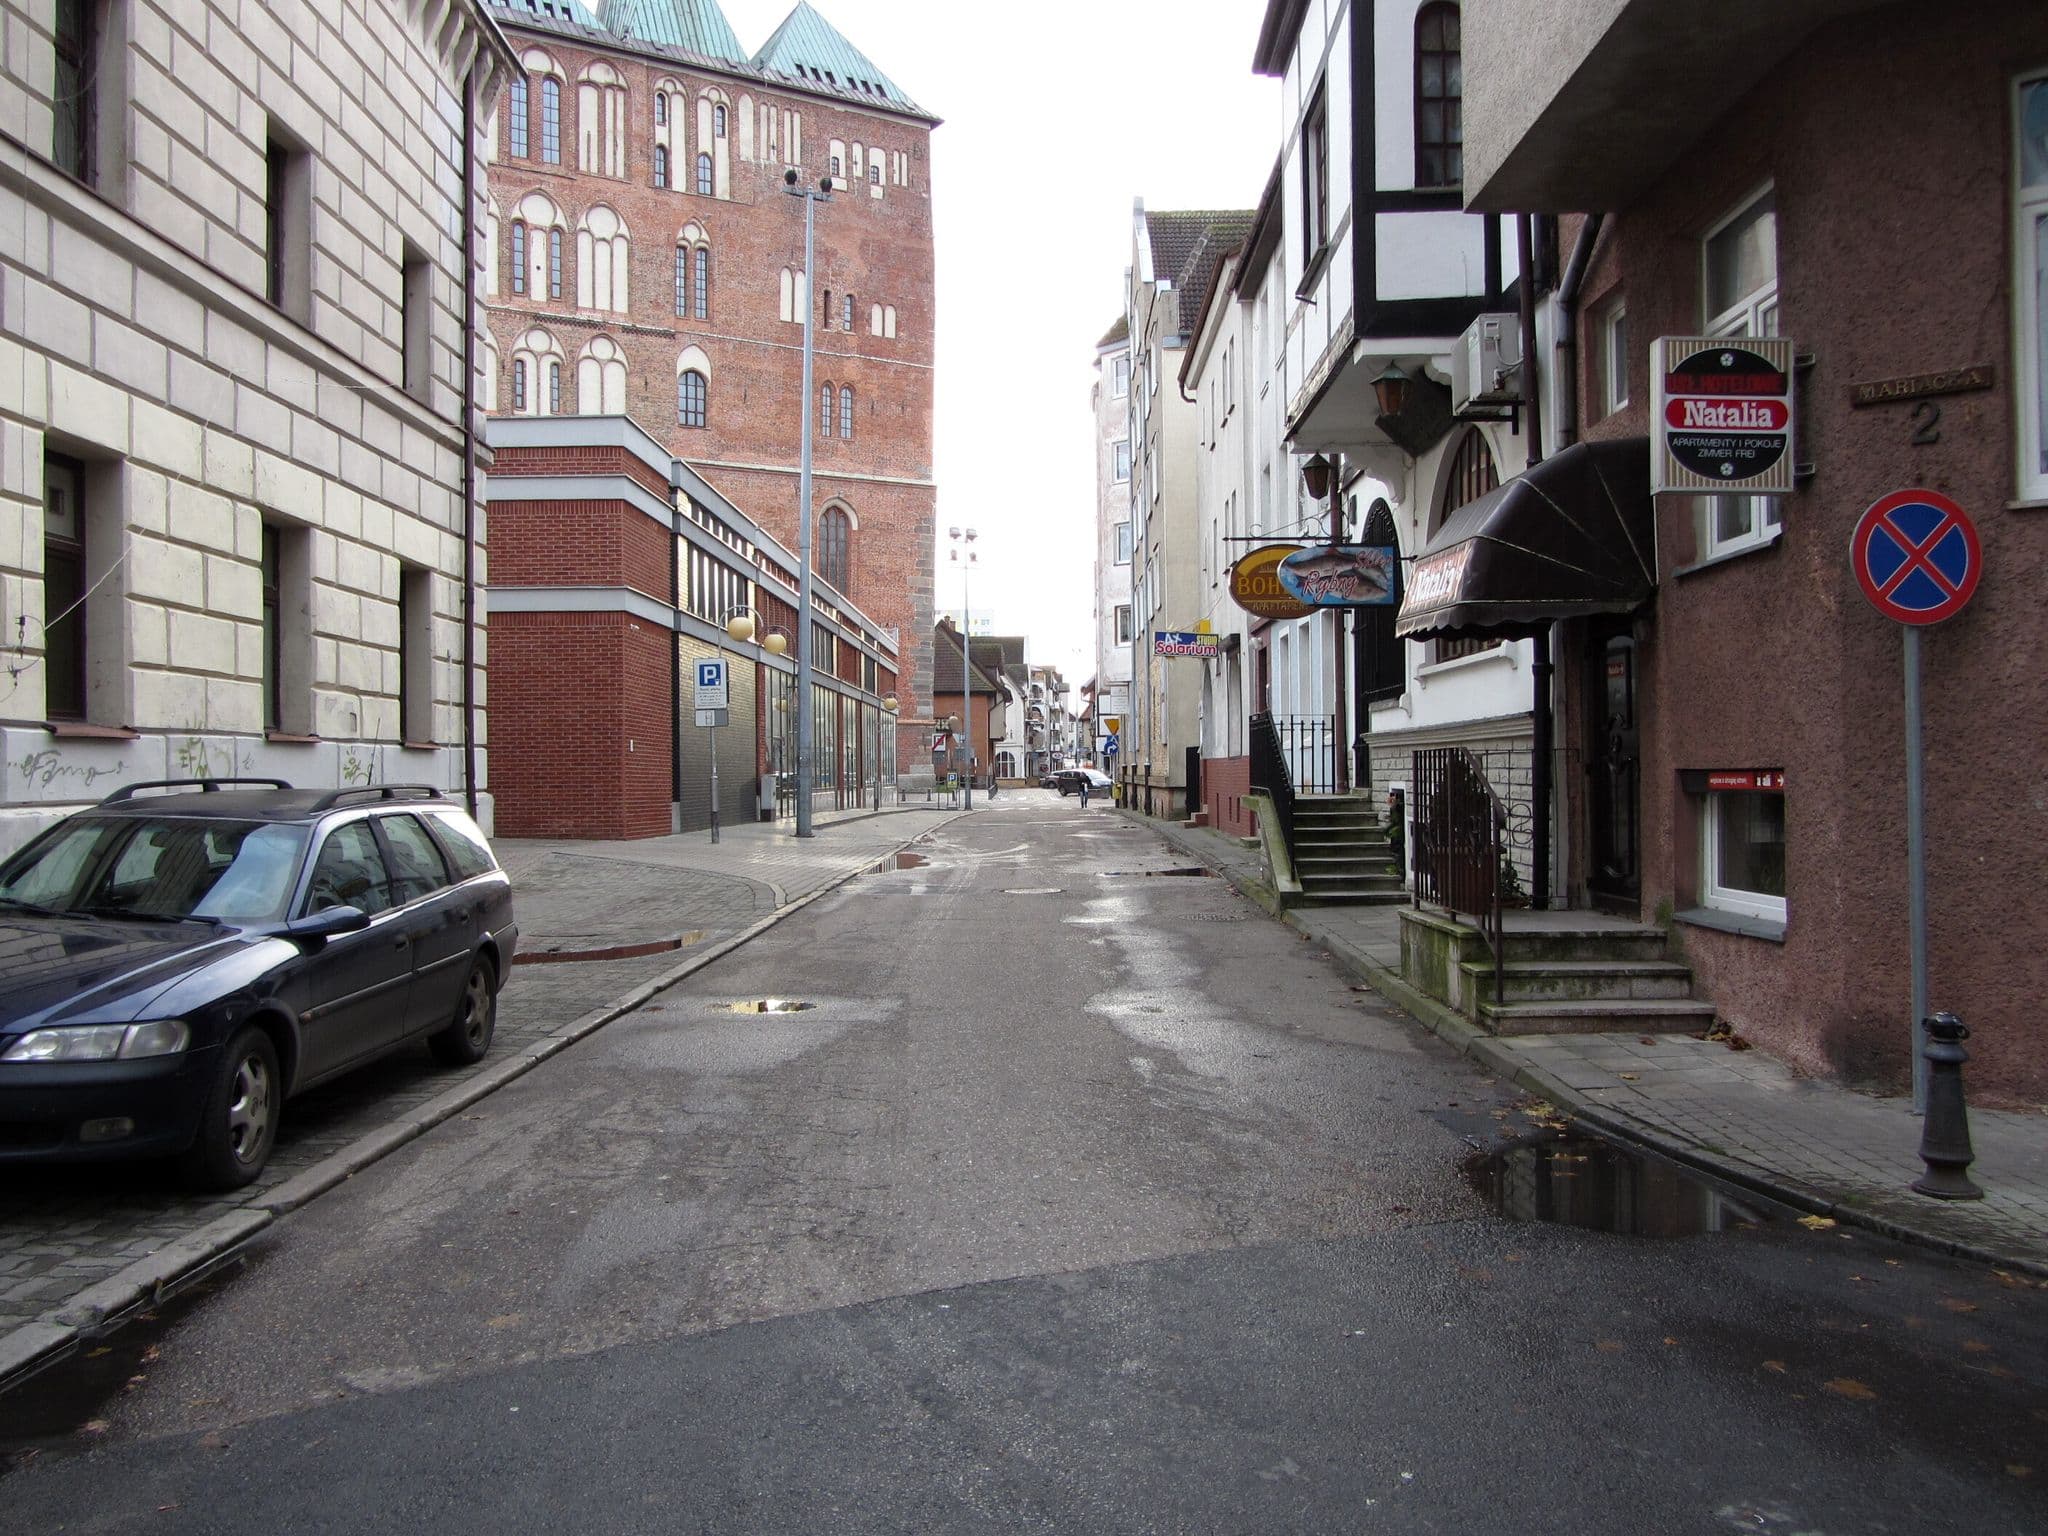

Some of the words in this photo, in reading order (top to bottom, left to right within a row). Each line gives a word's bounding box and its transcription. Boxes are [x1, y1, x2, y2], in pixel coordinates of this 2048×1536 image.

[1858, 370, 1982, 399] MARIACA
[1683, 401, 1773, 428] Natalia
[1911, 401, 1941, 446] 2
[1672, 438, 1736, 448] APARTAMENTY
[1744, 440, 1782, 448] POKOJE
[1698, 449, 1733, 458] ZIMMER
[1735, 450, 1755, 458] FREI
[1238, 576, 1289, 596] BOH
[1156, 641, 1217, 656] Solarium
[704, 666, 717, 684] P
